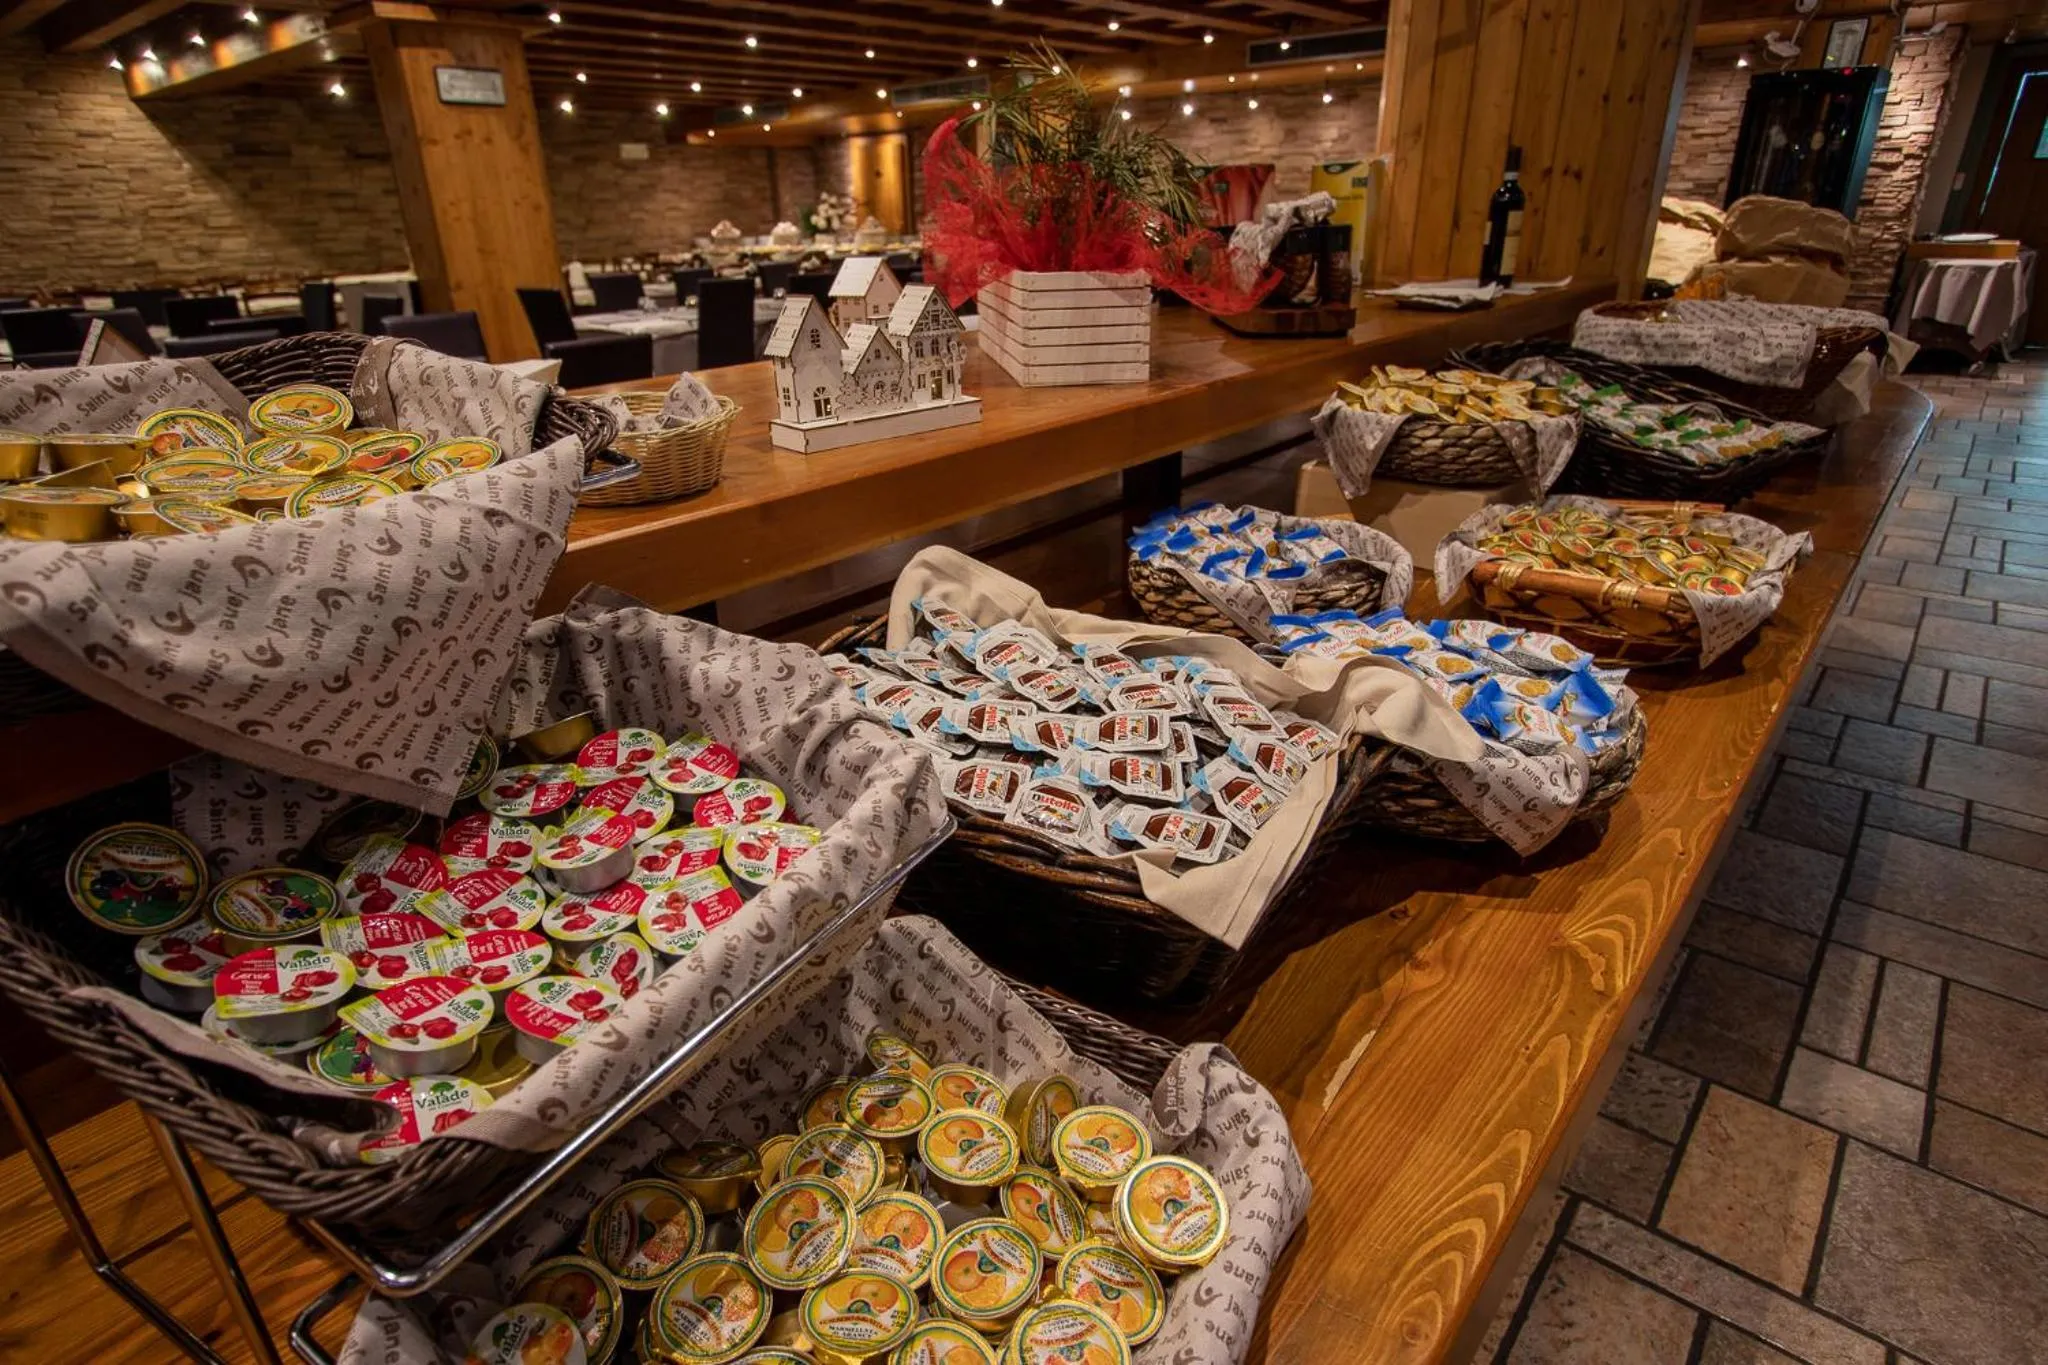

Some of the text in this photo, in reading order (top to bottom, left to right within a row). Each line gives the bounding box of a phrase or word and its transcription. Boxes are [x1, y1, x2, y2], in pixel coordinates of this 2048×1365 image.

[53, 368, 90, 389] Saint
[150, 379, 176, 405] Jane
[76, 389, 113, 417] Saint
[478, 399, 493, 429] Saint
[519, 482, 536, 521] Saint
[544, 489, 561, 527] Saint
[415, 513, 437, 549] Jane
[456, 516, 473, 552] Jane
[286, 532, 315, 576] Saint
[330, 540, 356, 582] Saint
[480, 534, 500, 574] Jane
[126, 550, 159, 593] Jane
[177, 557, 211, 605] Jane
[367, 561, 393, 606] Saint
[404, 565, 431, 611] Saint
[219, 584, 250, 632] Jane
[265, 594, 298, 638] Jane
[431, 586, 460, 632] Saint
[304, 616, 332, 662] Jane
[348, 624, 374, 667] Jane
[191, 648, 230, 694] Saint
[367, 645, 399, 683] Jane
[400, 647, 429, 682] Jane
[435, 658, 461, 691] Jane
[539, 652, 556, 686] Saint
[596, 655, 614, 688] Saint
[678, 664, 691, 691] Jane
[222, 673, 269, 712] Saint
[264, 680, 308, 718] Saint
[450, 673, 475, 708] Jane
[754, 686, 772, 724] Saint
[1124, 687, 1162, 701] nutella
[287, 698, 330, 733] Saint
[322, 699, 362, 736] Saint
[530, 701, 546, 728] Jane
[733, 701, 748, 738] Saint
[1117, 716, 1128, 741] nutella
[394, 721, 423, 760] Saint
[423, 722, 452, 763] Saint
[761, 748, 789, 776] Jane
[839, 757, 868, 775] Jane
[1129, 758, 1141, 785] nutella
[1522, 765, 1545, 791] Saint
[727, 783, 762, 801] Valade
[835, 786, 856, 802] Jan
[1031, 793, 1082, 814] nutella
[1233, 785, 1264, 811] nutella
[1501, 776, 1526, 802] Saint
[210, 798, 227, 842] Saint
[247, 805, 264, 846] Saint
[284, 800, 301, 841] Saint
[870, 799, 885, 831] Jane
[491, 827, 530, 837] Valade
[506, 888, 537, 911] Valade
[889, 919, 919, 945] Saint
[279, 955, 331, 970] Valade
[589, 940, 617, 980] Valade
[721, 934, 743, 978] Saint
[931, 958, 959, 985] Jane
[862, 959, 889, 987] Saint
[917, 973, 942, 997] Jane
[448, 998, 481, 1022] Valade
[853, 987, 884, 1015] Saint
[908, 1001, 933, 1029] Jane
[645, 1001, 665, 1039] Jane
[837, 1007, 866, 1037] Saint
[893, 1018, 920, 1045] Jane
[957, 1011, 987, 1044] Saint
[997, 1048, 1027, 1073] Jane
[1015, 1032, 1043, 1061] Jane
[553, 1049, 578, 1090] Saint
[416, 1088, 470, 1110] Valade
[1216, 1108, 1251, 1136] Saint
[1223, 1260, 1261, 1294] Jane
[376, 1313, 405, 1365] Jane
[1204, 1319, 1237, 1347] ane
